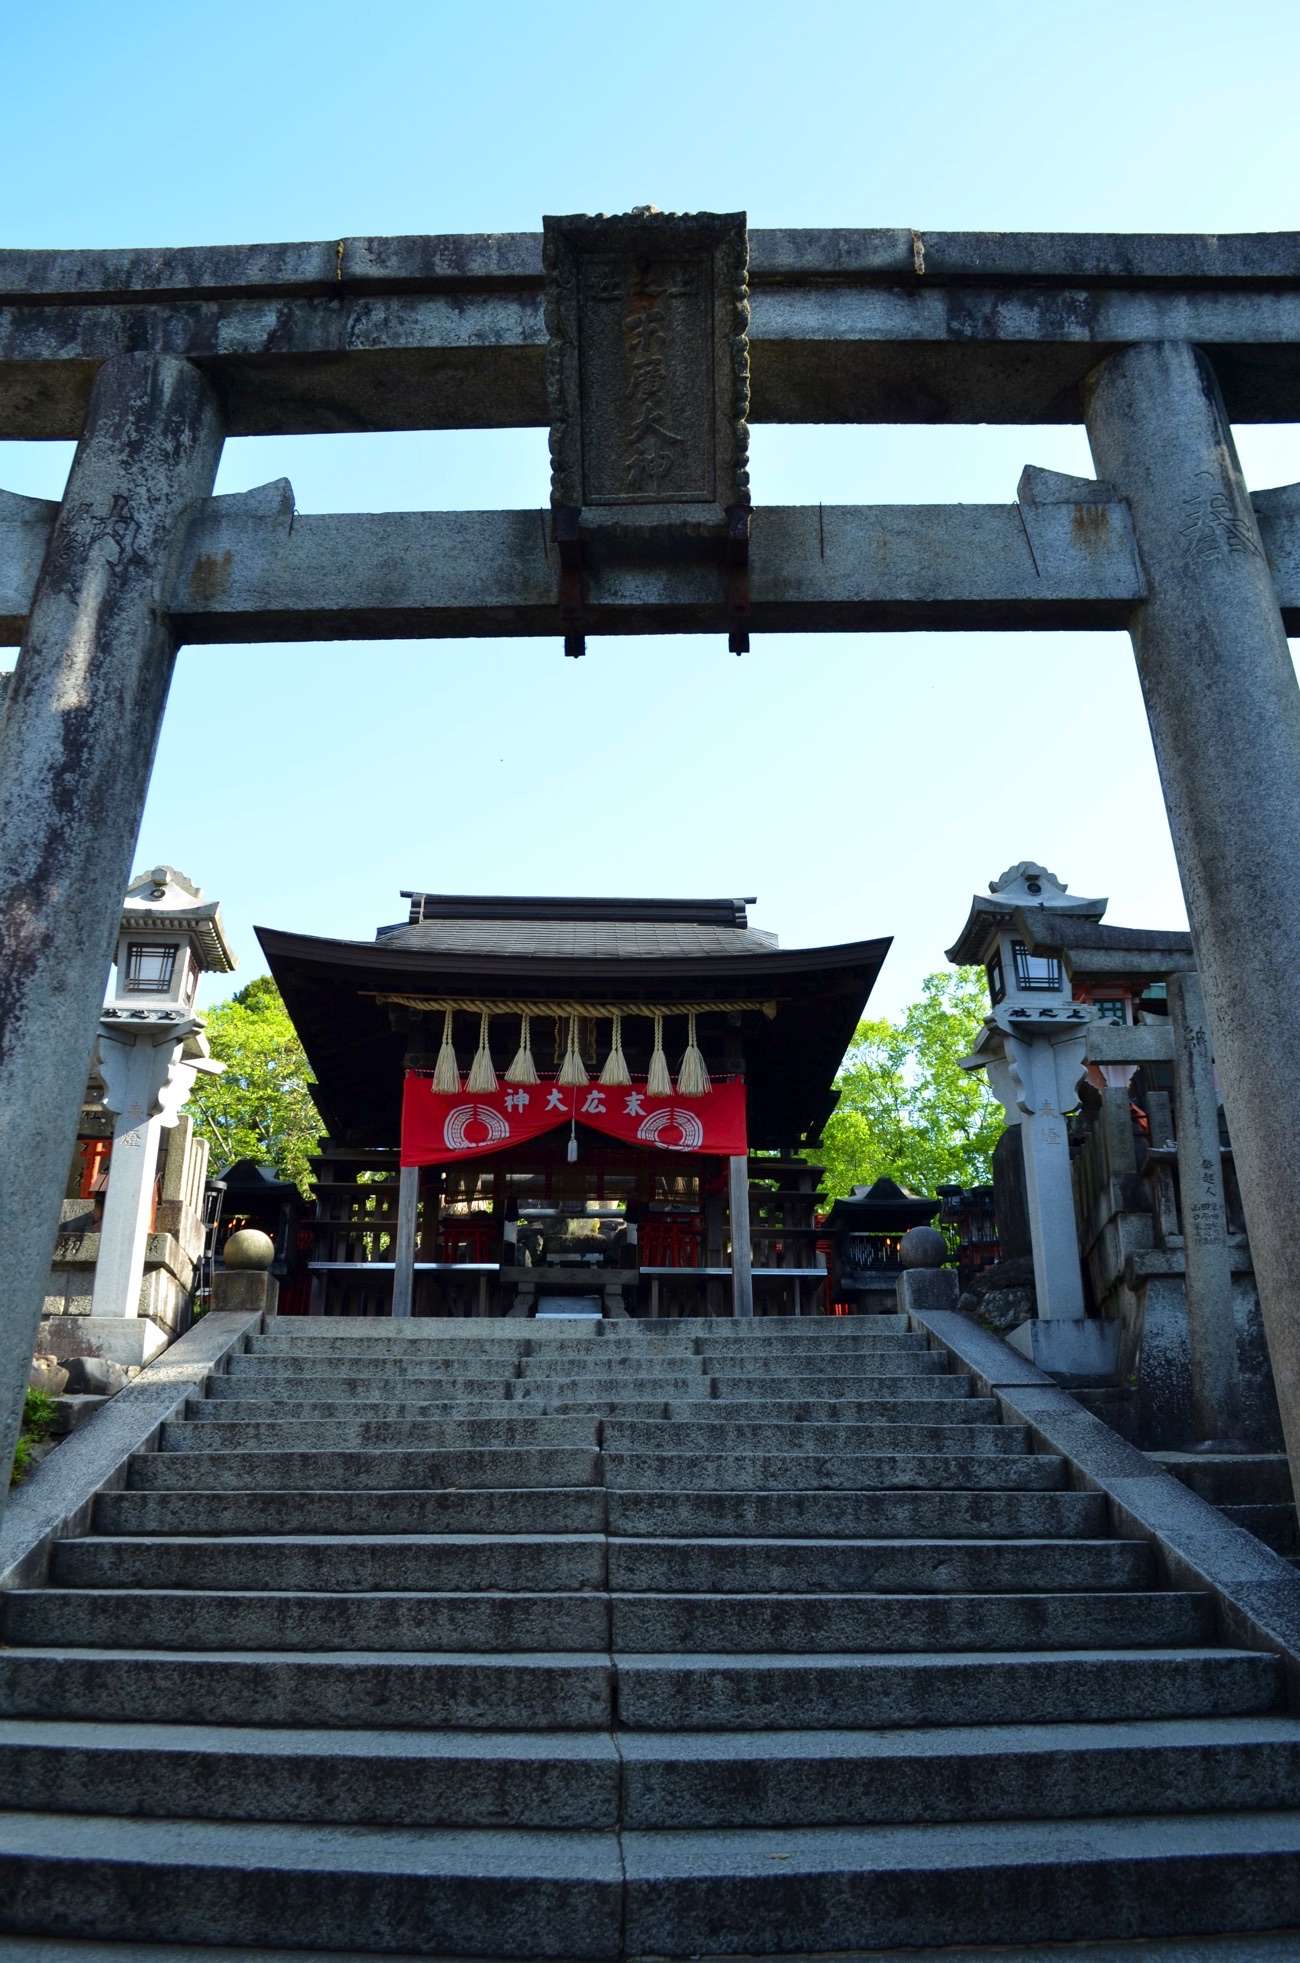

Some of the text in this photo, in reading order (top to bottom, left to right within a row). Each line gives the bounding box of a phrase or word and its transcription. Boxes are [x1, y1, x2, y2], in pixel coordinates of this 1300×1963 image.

[1008, 1008, 1086, 1020] 上之社
[504, 1088, 648, 1117] 末広大神
